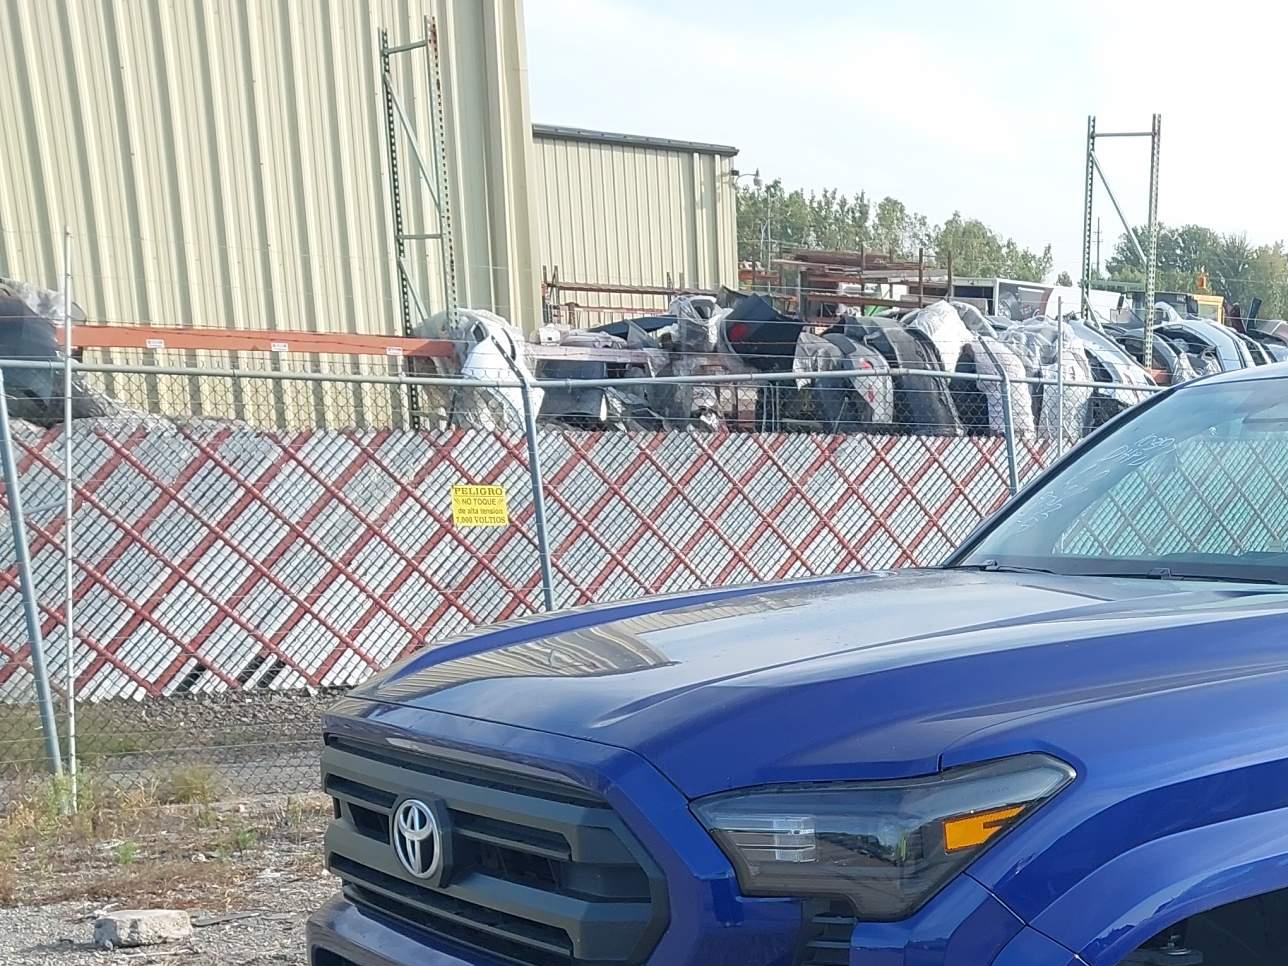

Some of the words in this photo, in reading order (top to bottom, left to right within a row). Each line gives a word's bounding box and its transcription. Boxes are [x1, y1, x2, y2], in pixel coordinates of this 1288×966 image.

[454, 487, 503, 496] PELIGRO
[461, 498, 472, 506] NO
[474, 498, 497, 506] TOQUE
[467, 507, 479, 515] alta
[474, 516, 506, 524] VOLTIOS
